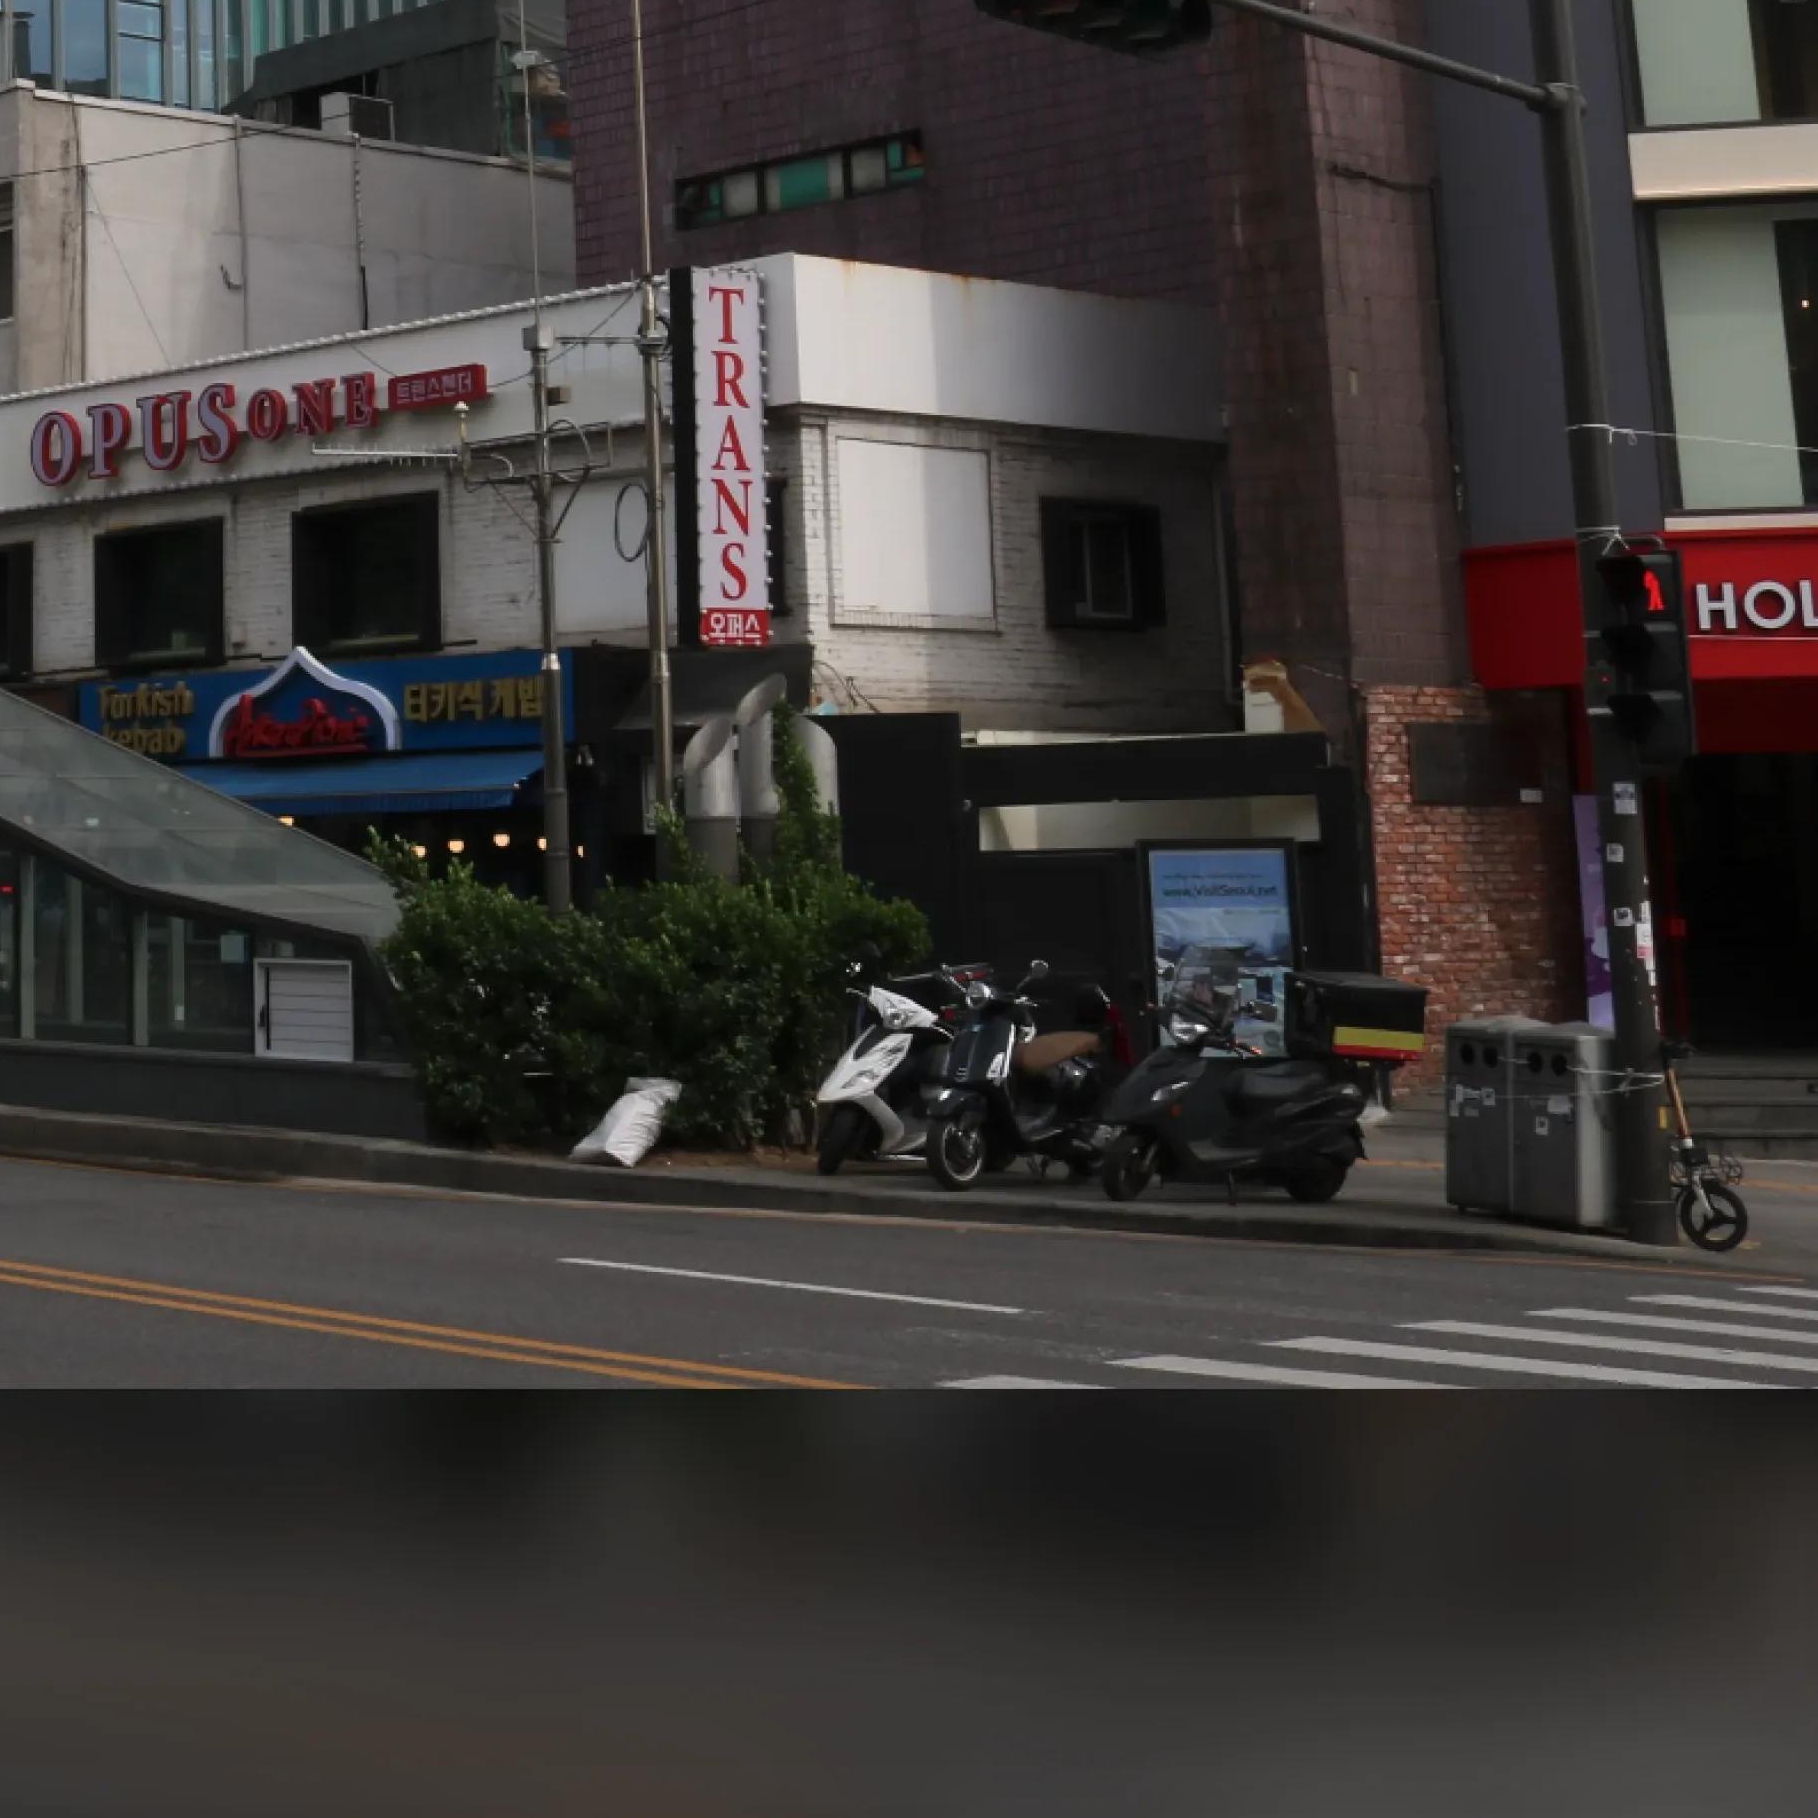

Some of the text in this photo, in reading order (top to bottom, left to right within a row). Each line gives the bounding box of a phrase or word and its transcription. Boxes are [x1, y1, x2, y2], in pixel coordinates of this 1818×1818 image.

[30, 371, 376, 486] OPUS ONE
[708, 285, 754, 601] TRANS
[99, 681, 195, 719] Turkish
[404, 679, 484, 723] 터키식
